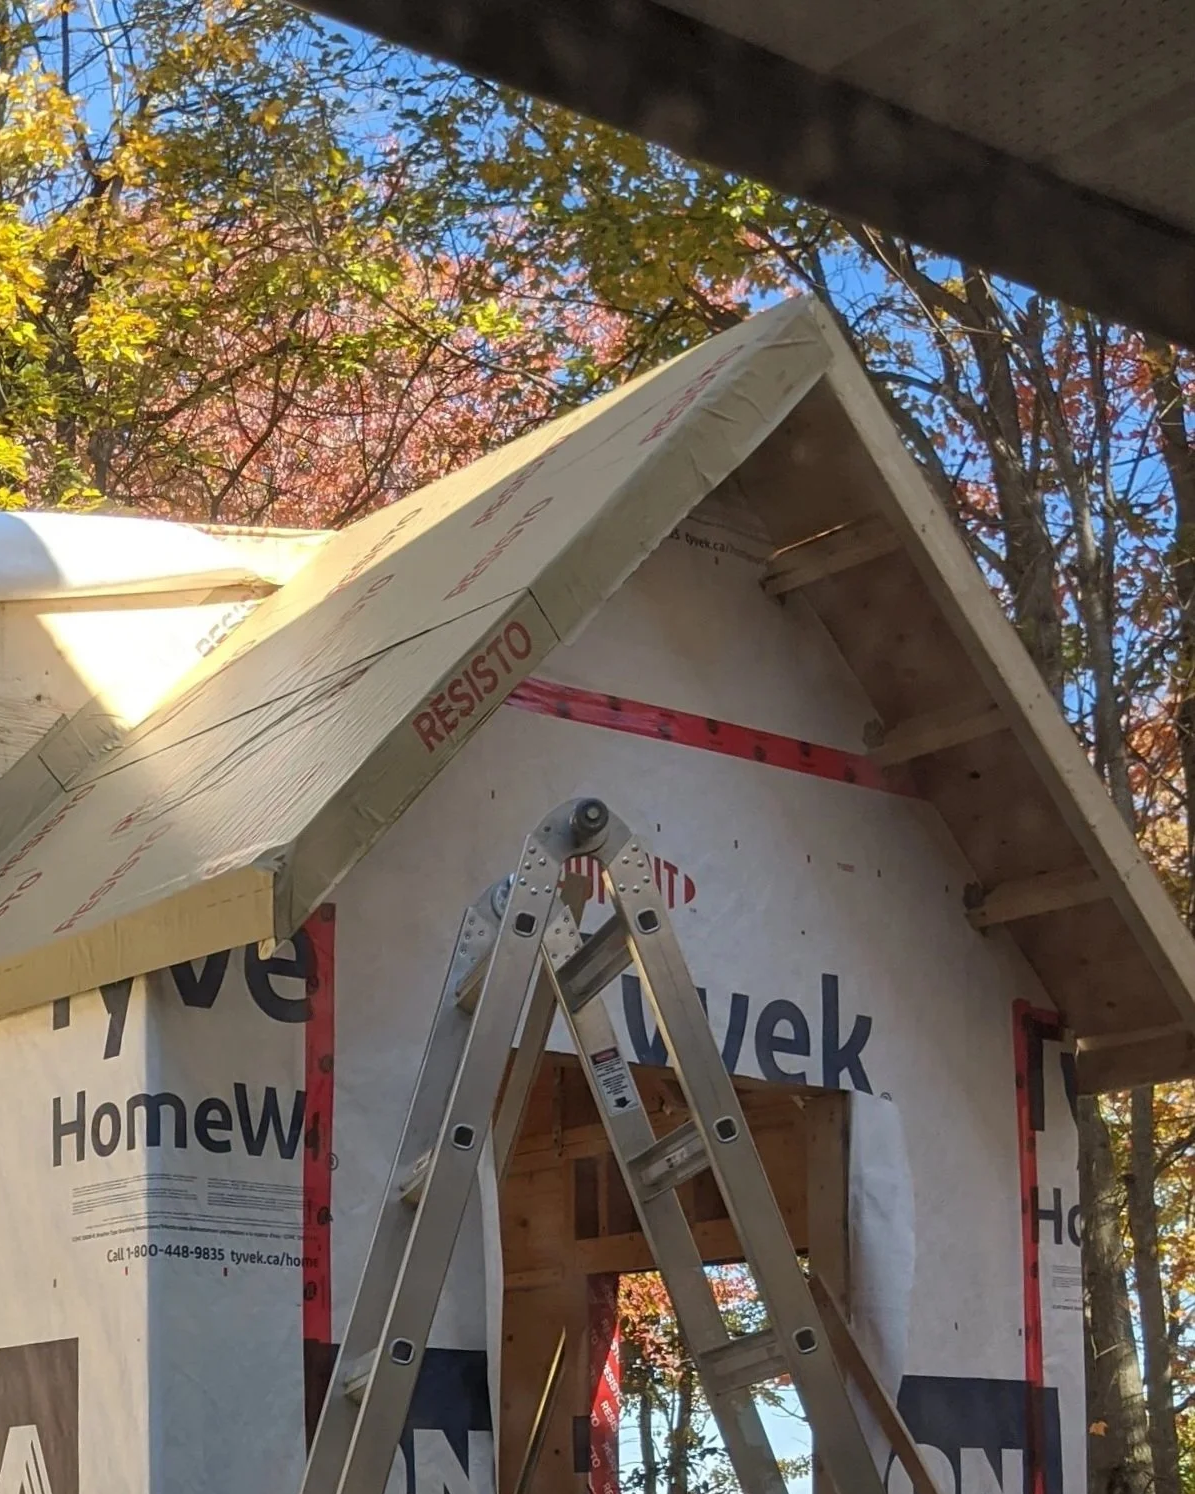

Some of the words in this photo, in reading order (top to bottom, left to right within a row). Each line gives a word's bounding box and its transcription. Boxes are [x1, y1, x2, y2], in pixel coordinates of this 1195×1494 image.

[412, 621, 533, 754] RESISTO
[106, 1249, 124, 1263] Call
[126, 1243, 225, 1262] 1-800-448-9835
